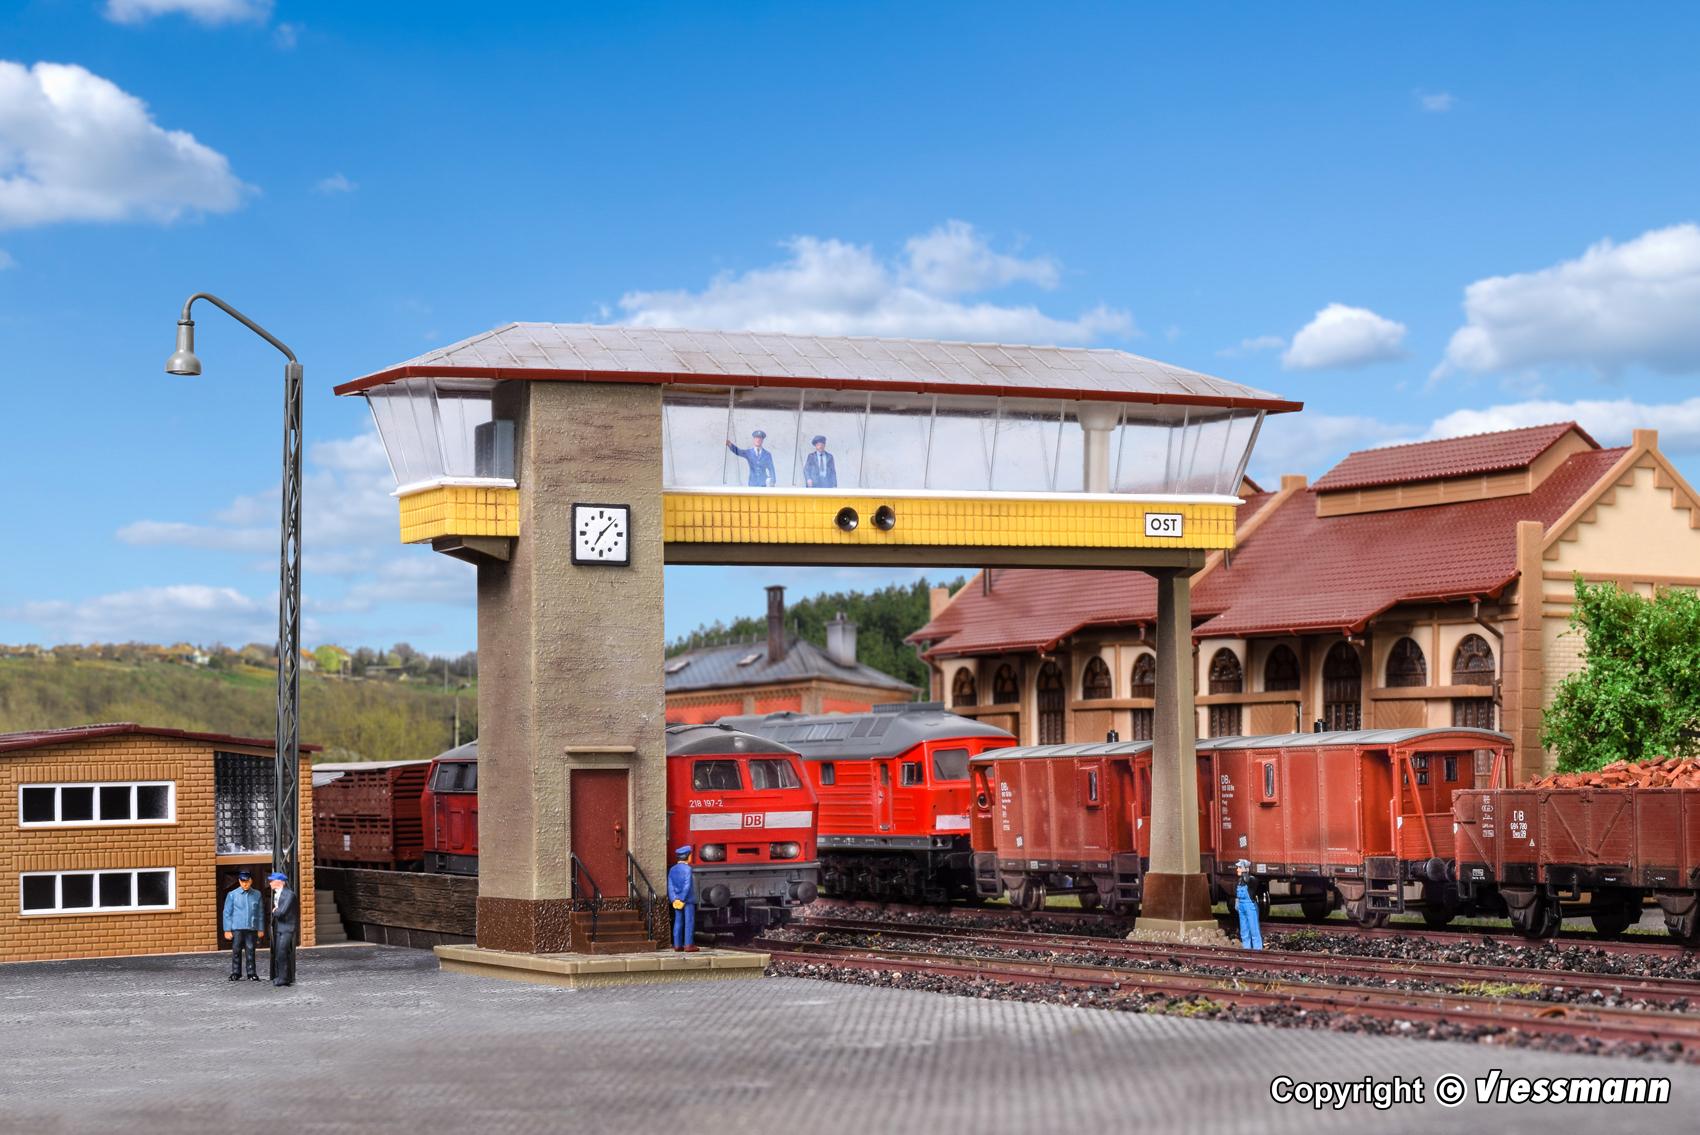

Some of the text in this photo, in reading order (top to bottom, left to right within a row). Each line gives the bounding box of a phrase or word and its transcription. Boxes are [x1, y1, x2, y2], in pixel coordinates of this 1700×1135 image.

[1150, 517, 1178, 531] OST
[689, 799, 724, 808] 218 197-2
[745, 815, 762, 826] DB
